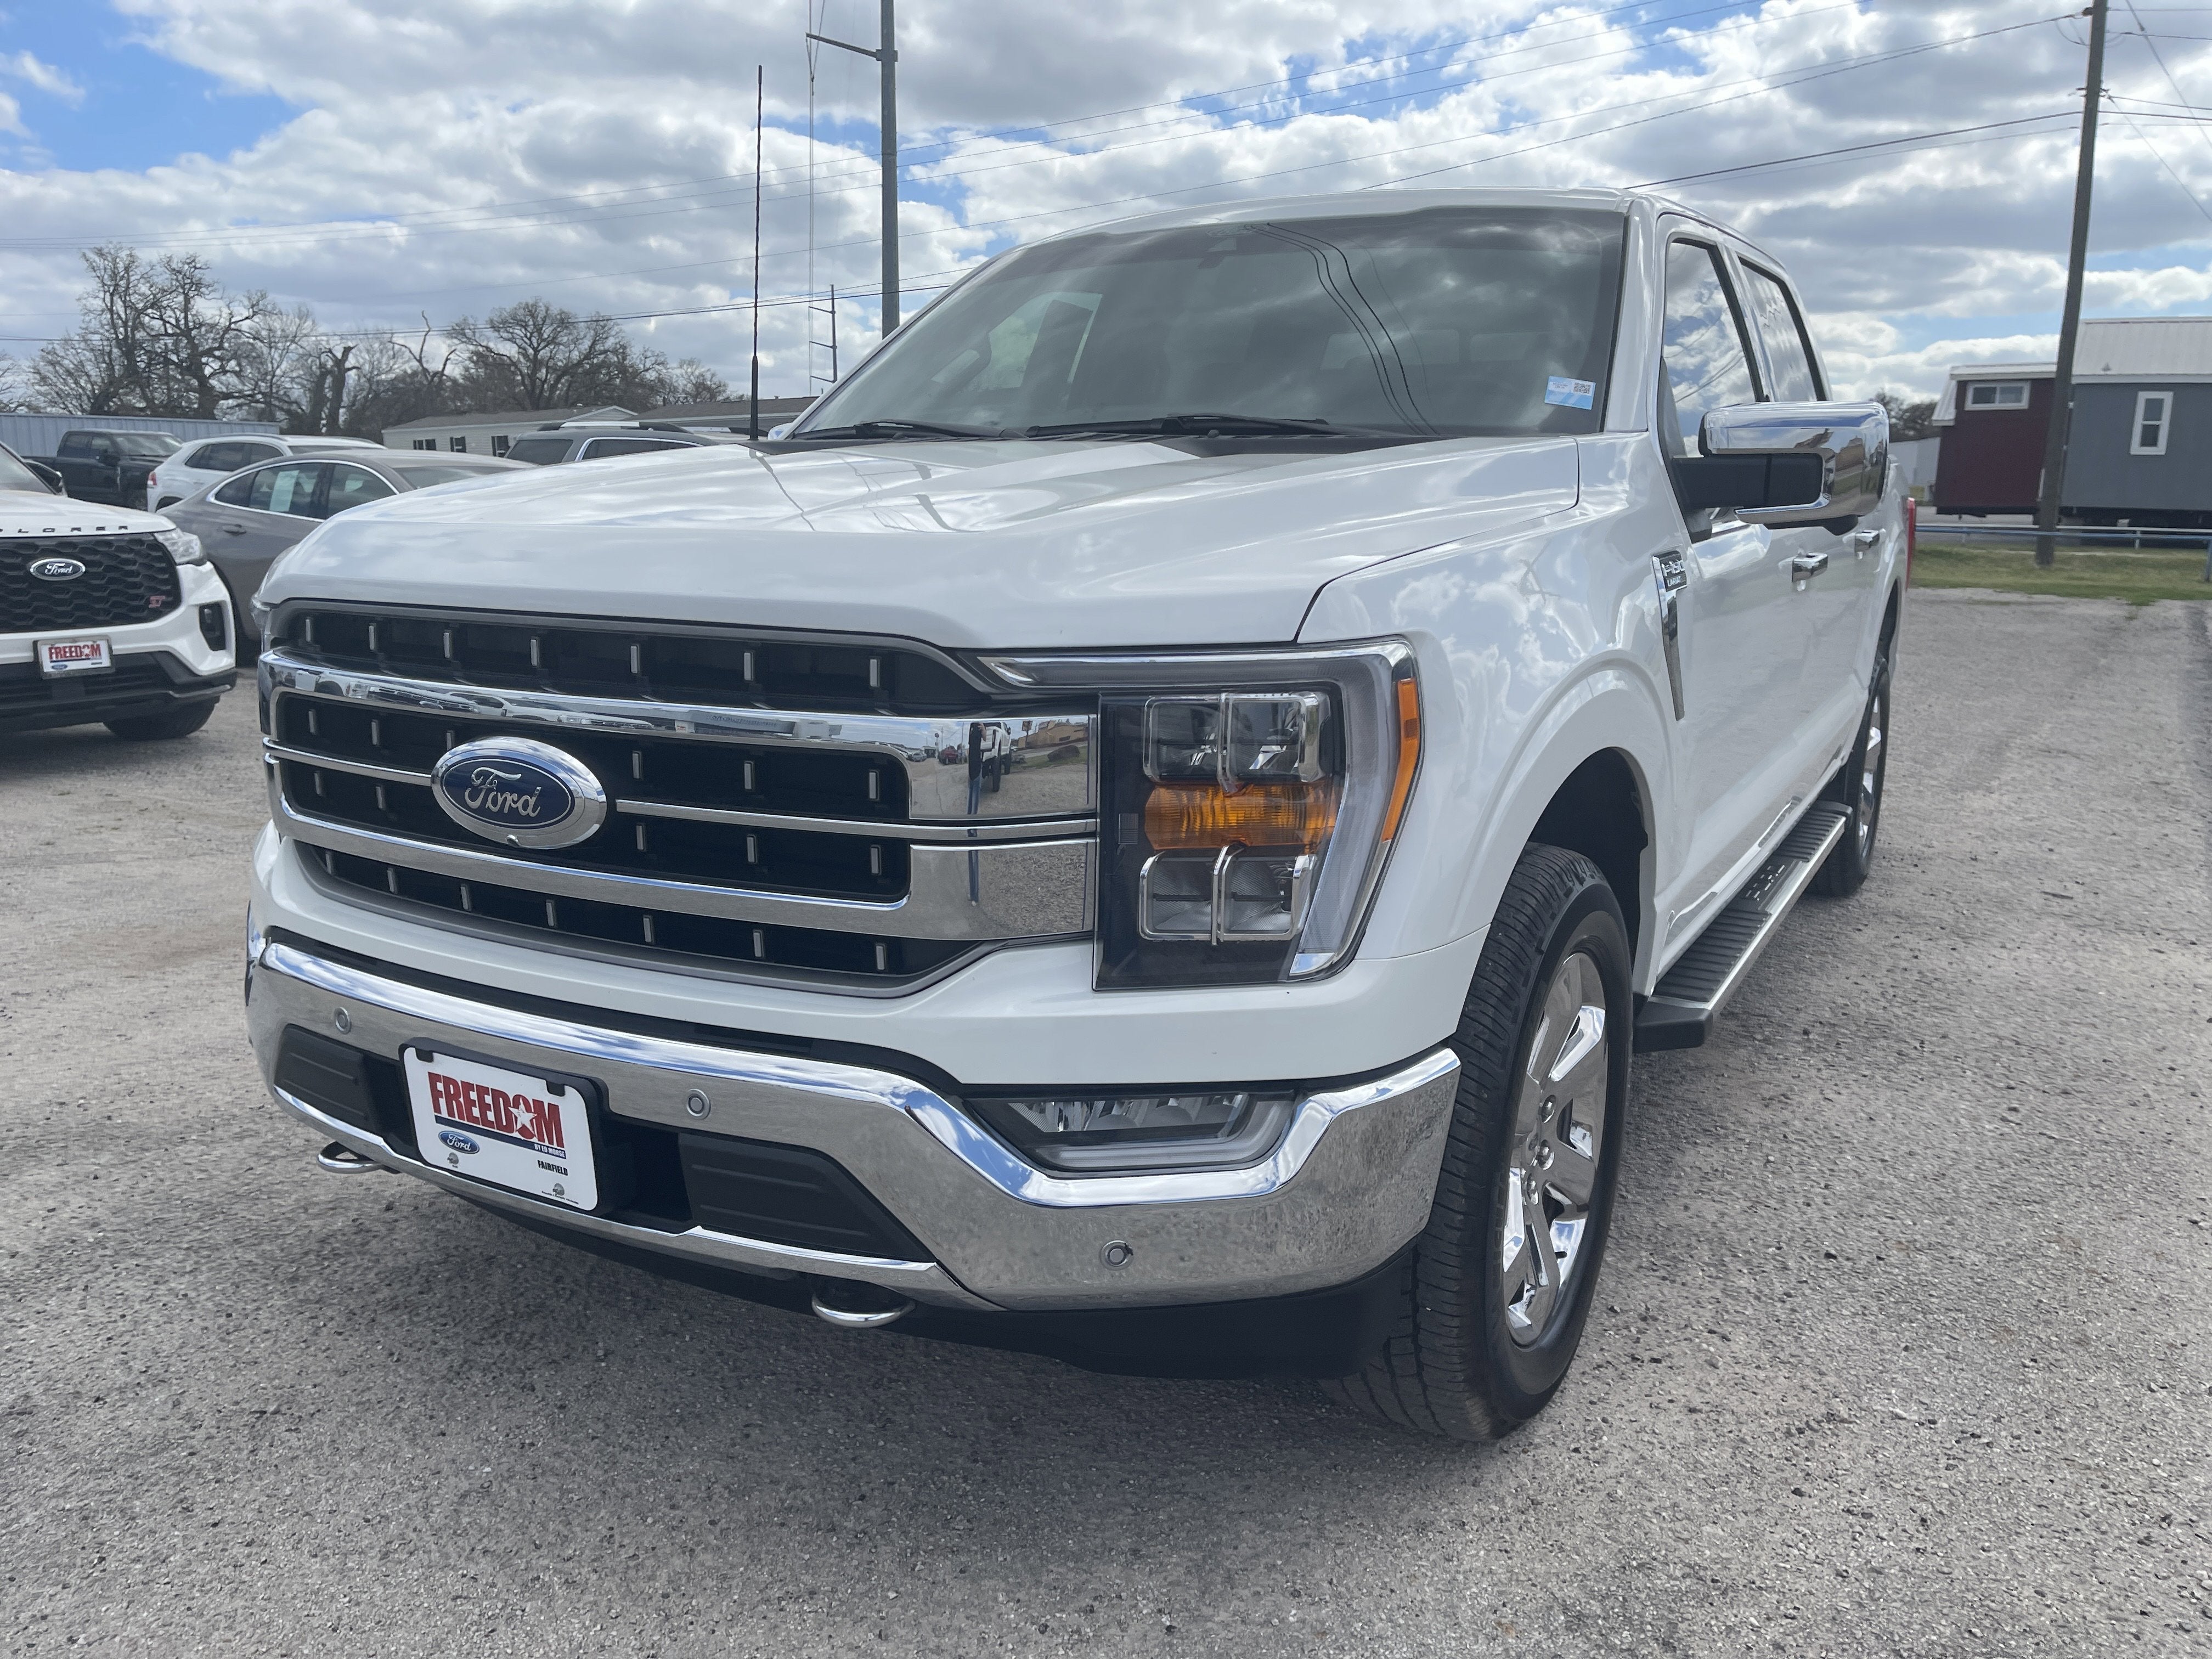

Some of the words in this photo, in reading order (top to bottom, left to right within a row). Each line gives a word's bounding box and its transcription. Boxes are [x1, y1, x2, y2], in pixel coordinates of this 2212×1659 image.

[44, 563, 73, 575] Ford
[48, 644, 101, 659] FREEDOM
[464, 766, 541, 817] Ford
[427, 1071, 565, 1149] FREEDOM
[447, 1133, 471, 1151] Ford
[538, 1160, 568, 1176] FAIRFIELD
